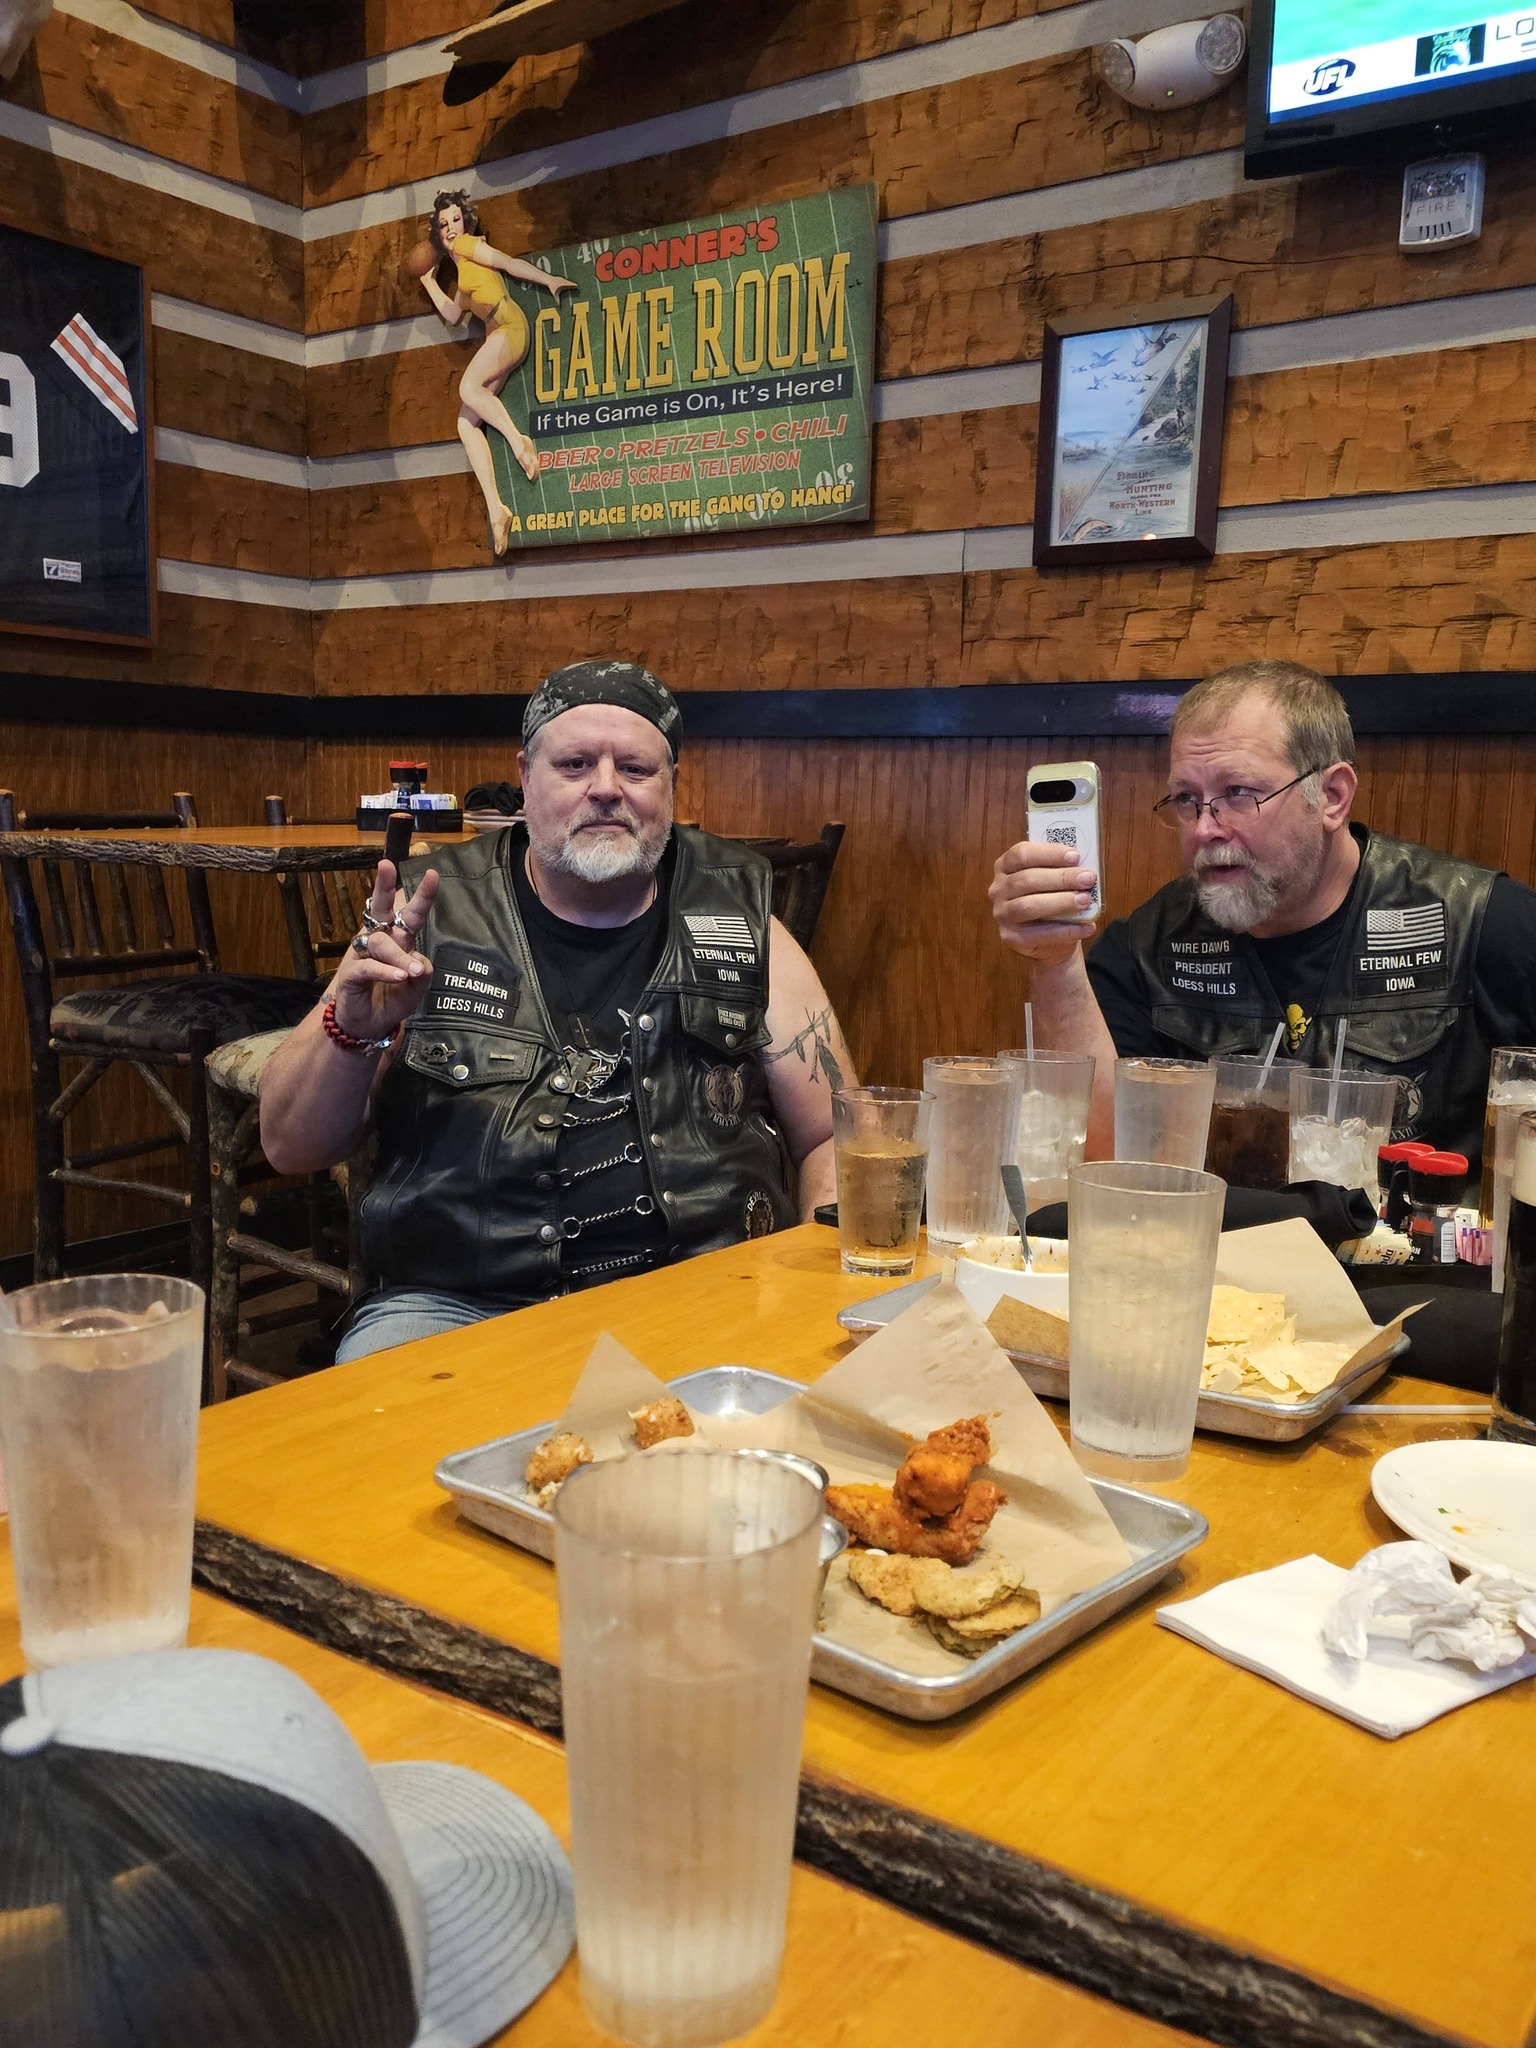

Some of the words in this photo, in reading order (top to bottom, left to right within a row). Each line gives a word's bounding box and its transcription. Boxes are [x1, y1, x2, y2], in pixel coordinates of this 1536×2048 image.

[1310, 64, 1348, 92] UFL
[1416, 200, 1455, 216] FIRE
[595, 216, 780, 282] CONNER'S
[533, 285, 674, 404] GAME
[692, 252, 851, 382] ROOM
[537, 414, 551, 431] If
[555, 411, 590, 429] the
[595, 403, 658, 423] Game
[663, 398, 681, 414] is
[686, 393, 725, 411] On,
[732, 385, 770, 406] It's
[776, 373, 843, 399] Here!
[538, 445, 601, 471] BEER
[618, 427, 750, 462] PRETZELS
[770, 413, 848, 443] CHILI
[569, 469, 623, 493] LARGE
[628, 461, 692, 487] SCREEN
[699, 449, 801, 479] TELEVISION
[1126, 483, 1173, 494] HUNTING
[511, 515, 522, 533] A
[526, 510, 574, 531] GREAT
[579, 505, 626, 527] PLACE
[631, 502, 665, 522] FOR
[669, 499, 701, 519] THE
[706, 494, 757, 515] GANG
[761, 490, 786, 510] TO
[791, 483, 854, 507] HANG!
[1109, 498, 1176, 511] NORTH-WESTERN
[692, 948, 736, 963] ETERNAL
[736, 951, 755, 965] FEW
[1171, 942, 1199, 954] WIRE
[1201, 940, 1230, 954] DAWG
[467, 959, 490, 976] UGG
[1175, 961, 1233, 975] PRESIDENT
[1360, 954, 1414, 971] ETERNAL
[1416, 949, 1442, 966] FEW
[717, 968, 740, 983] IOWA
[1172, 976, 1204, 993] LOESS
[1206, 982, 1236, 995] HILLS
[1386, 976, 1416, 991] IOWA
[444, 973, 508, 1001] TREASURER
[436, 996, 471, 1012] LOESS
[473, 1001, 505, 1019] HILLS
